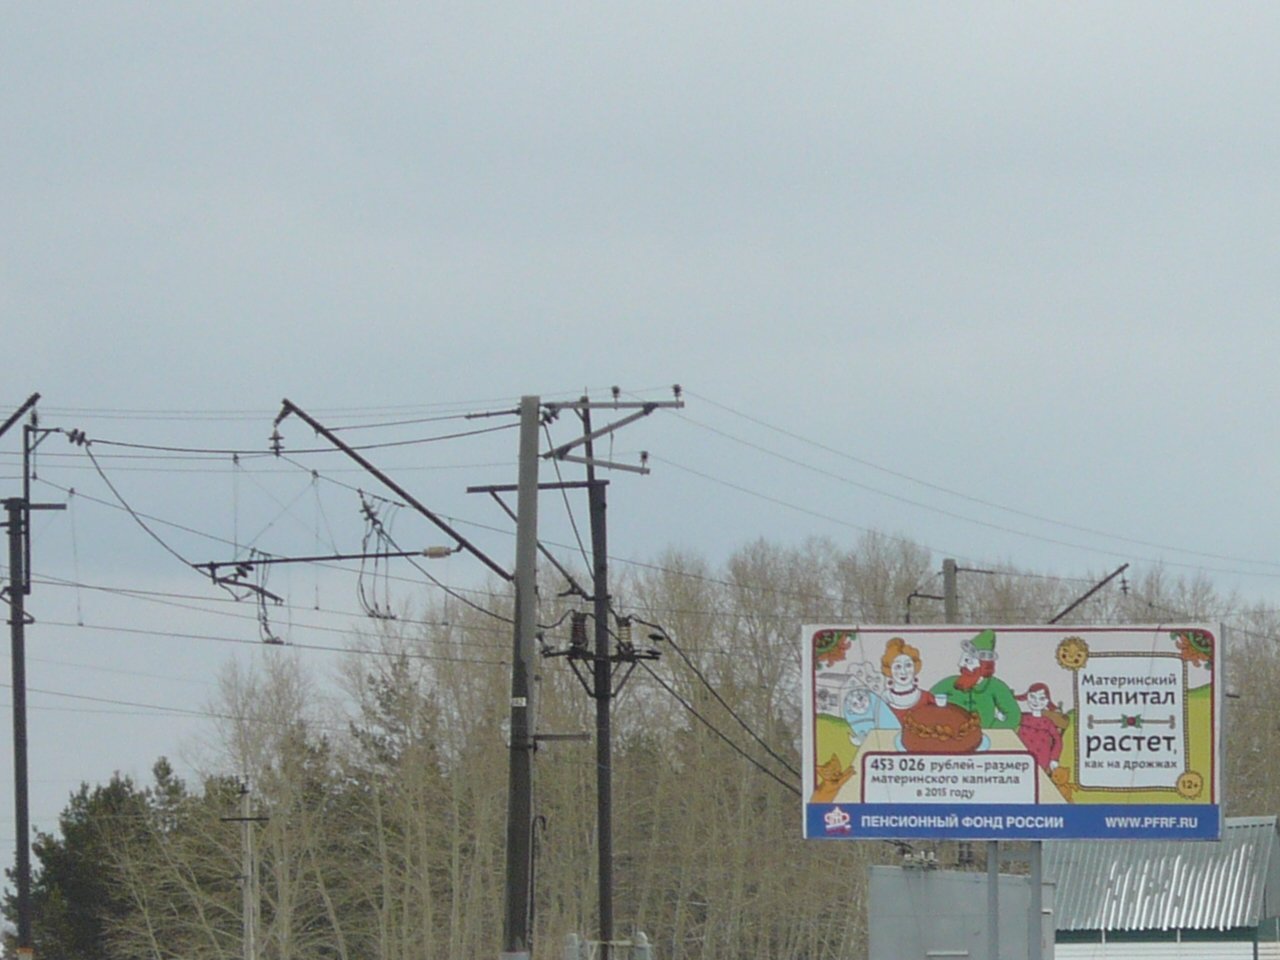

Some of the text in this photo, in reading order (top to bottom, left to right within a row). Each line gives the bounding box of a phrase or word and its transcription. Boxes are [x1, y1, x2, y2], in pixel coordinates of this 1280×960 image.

[1081, 673, 1177, 688] Материнский
[1086, 690, 1175, 705] капитал
[1086, 734, 1177, 758] растет,
[870, 758, 894, 771] 453
[898, 758, 925, 771] 026
[930, 758, 975, 773] рублей
[984, 760, 1029, 774] размер
[1084, 760, 1177, 770] как на дрожжах
[871, 774, 1020, 786] материнского капитала
[1181, 780, 1198, 790] 12+
[916, 788, 975, 799] в 2015 году
[861, 813, 1064, 829] ПЕНСИОННЫЙ ФОНД РОССИИ
[1105, 816, 1198, 829] WWW.PFRF.RU
